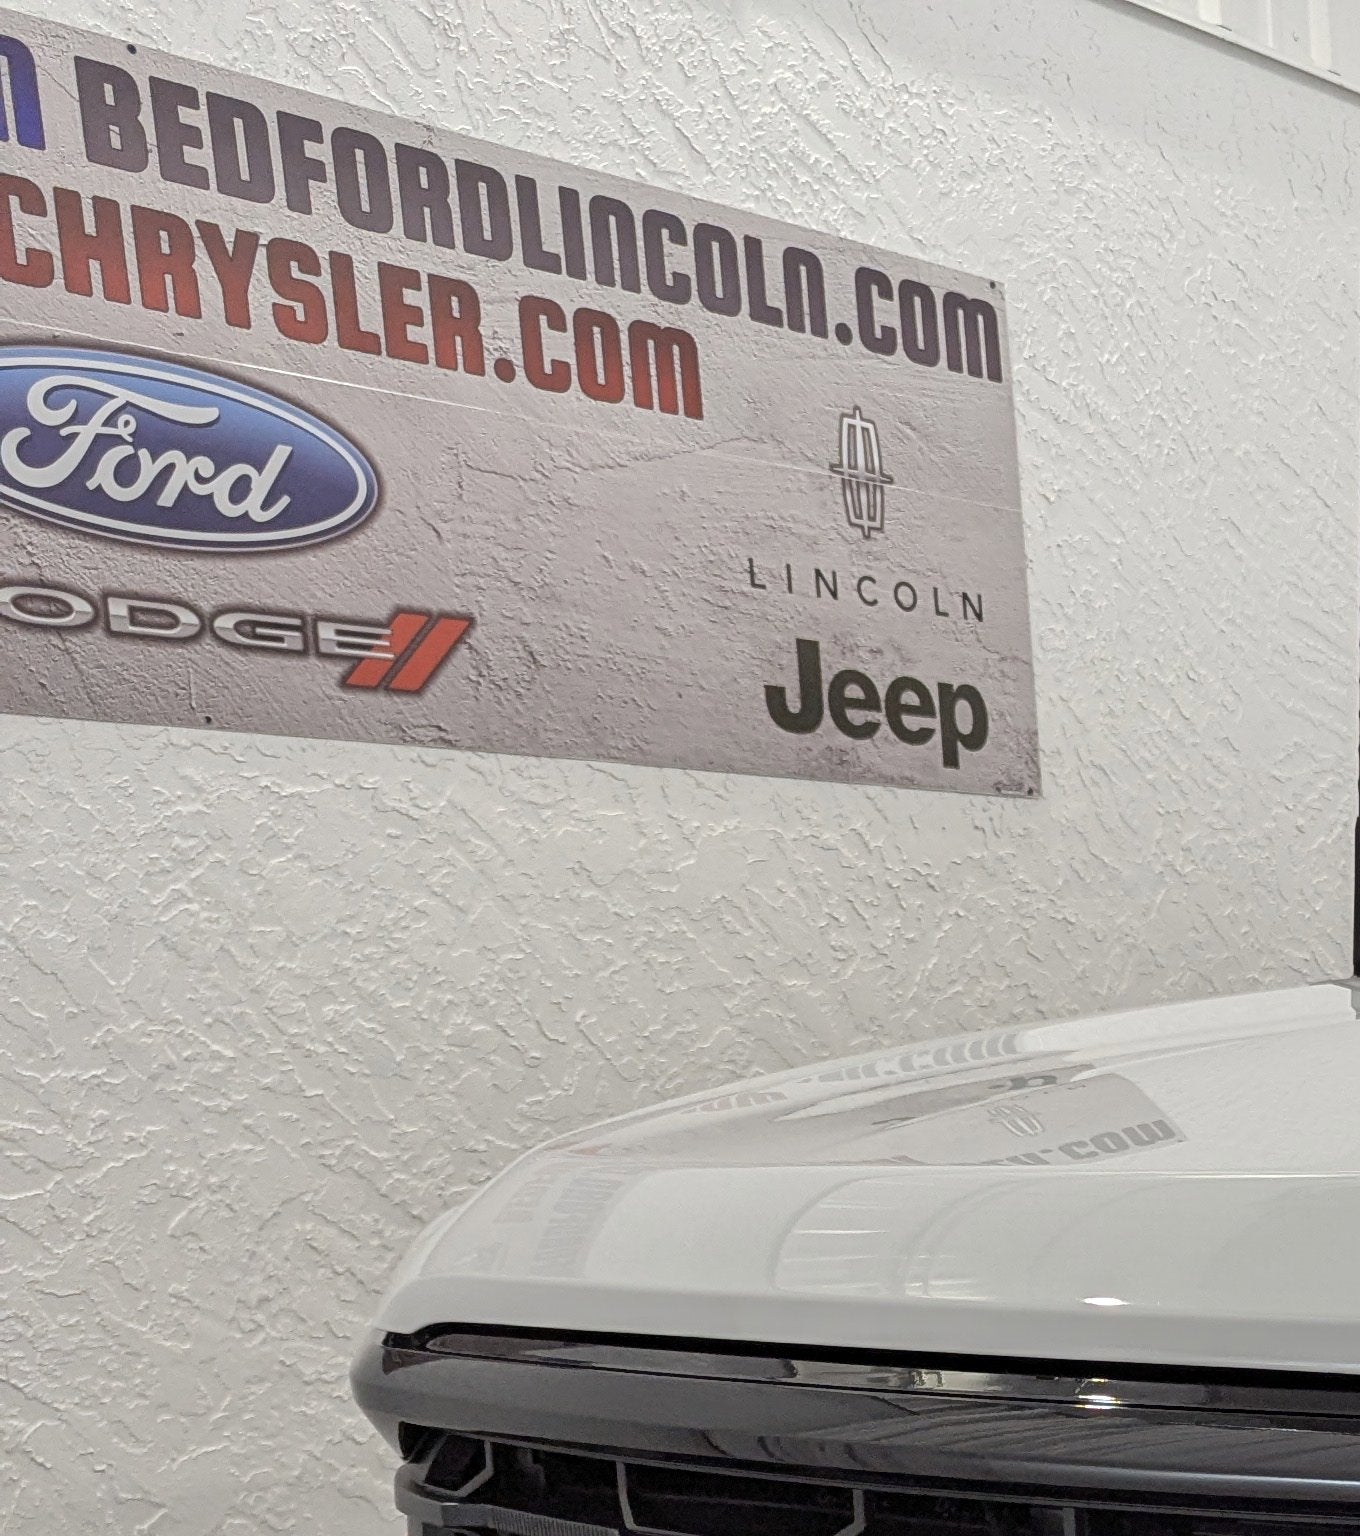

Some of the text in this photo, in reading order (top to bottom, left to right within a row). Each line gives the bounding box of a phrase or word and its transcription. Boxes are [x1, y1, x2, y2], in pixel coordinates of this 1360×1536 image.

[74, 55, 1003, 384] BEDFORDLINCOLN.COM
[0, 172, 704, 421] CHRYSLER.COM
[0, 374, 294, 523] Ford
[747, 557, 984, 622] LINCOLN
[763, 637, 990, 769] Jeep
